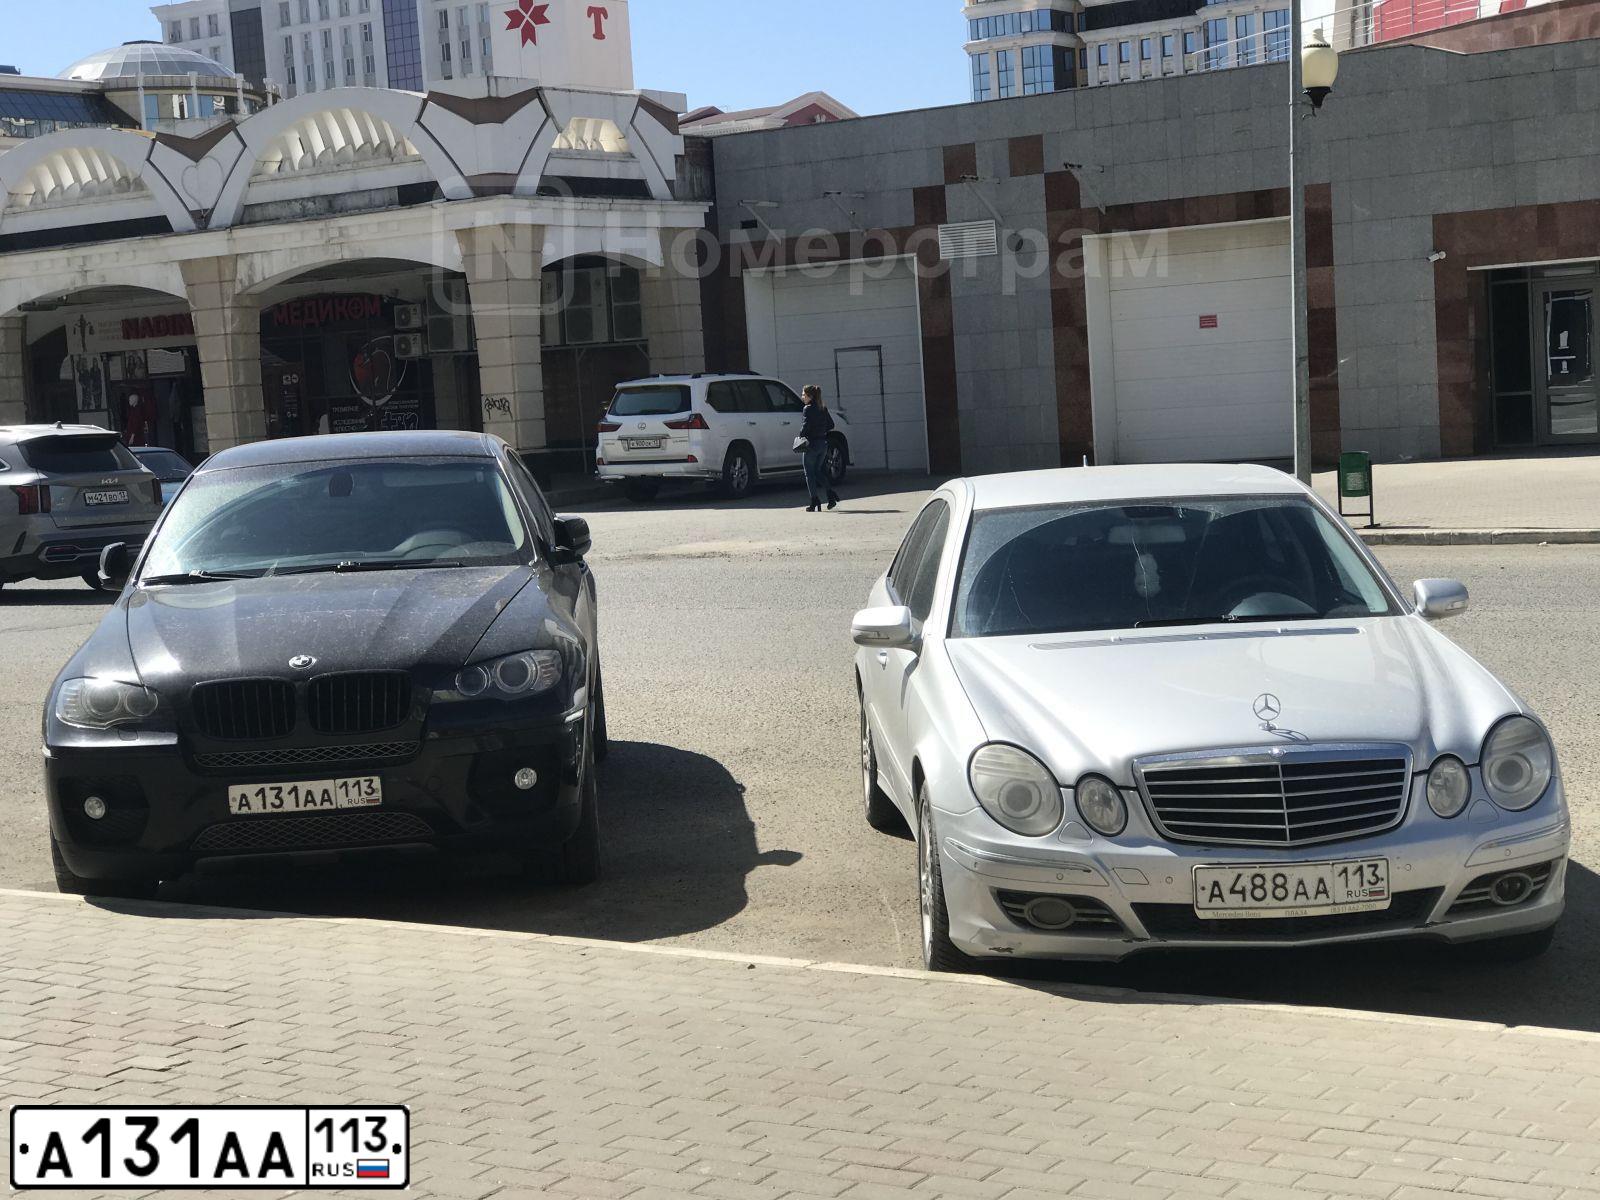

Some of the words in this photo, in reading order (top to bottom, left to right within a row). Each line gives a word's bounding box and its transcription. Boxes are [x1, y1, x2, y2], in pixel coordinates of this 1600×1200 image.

[272, 295, 382, 327] МЕДИКОМ
[88, 492, 118, 503] М421ВО
[238, 785, 333, 811] А131АА
[339, 779, 376, 798] 113
[347, 797, 366, 805] RUS
[1208, 872, 1330, 904] А488АА
[1338, 863, 1378, 888] 113
[1346, 889, 1369, 899] RUS
